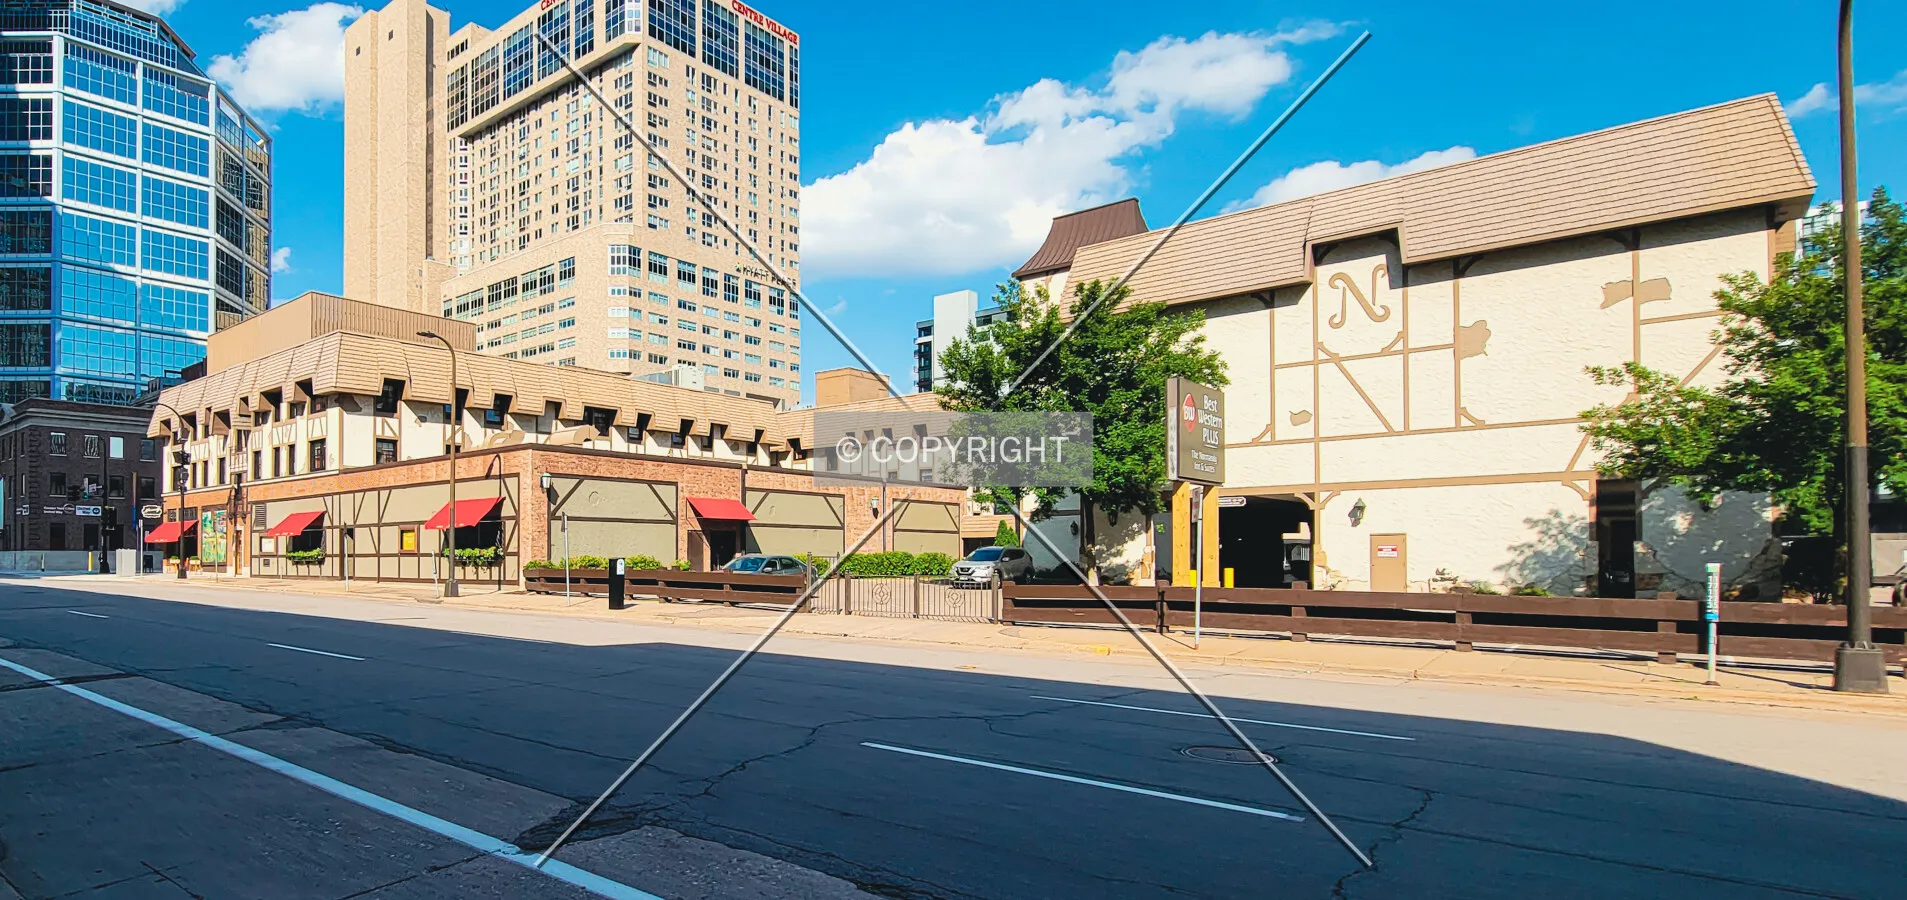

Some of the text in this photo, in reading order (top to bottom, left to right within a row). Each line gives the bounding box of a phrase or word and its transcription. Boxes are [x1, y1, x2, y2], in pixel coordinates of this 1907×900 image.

[732, 0, 798, 45] CENTRE VILLAGE
[743, 264, 769, 282] HYATT
[1203, 394, 1218, 413] Best
[1183, 405, 1196, 421] BW
[1197, 408, 1223, 430] Western
[1202, 427, 1219, 445] PLUS
[1191, 449, 1199, 459] The
